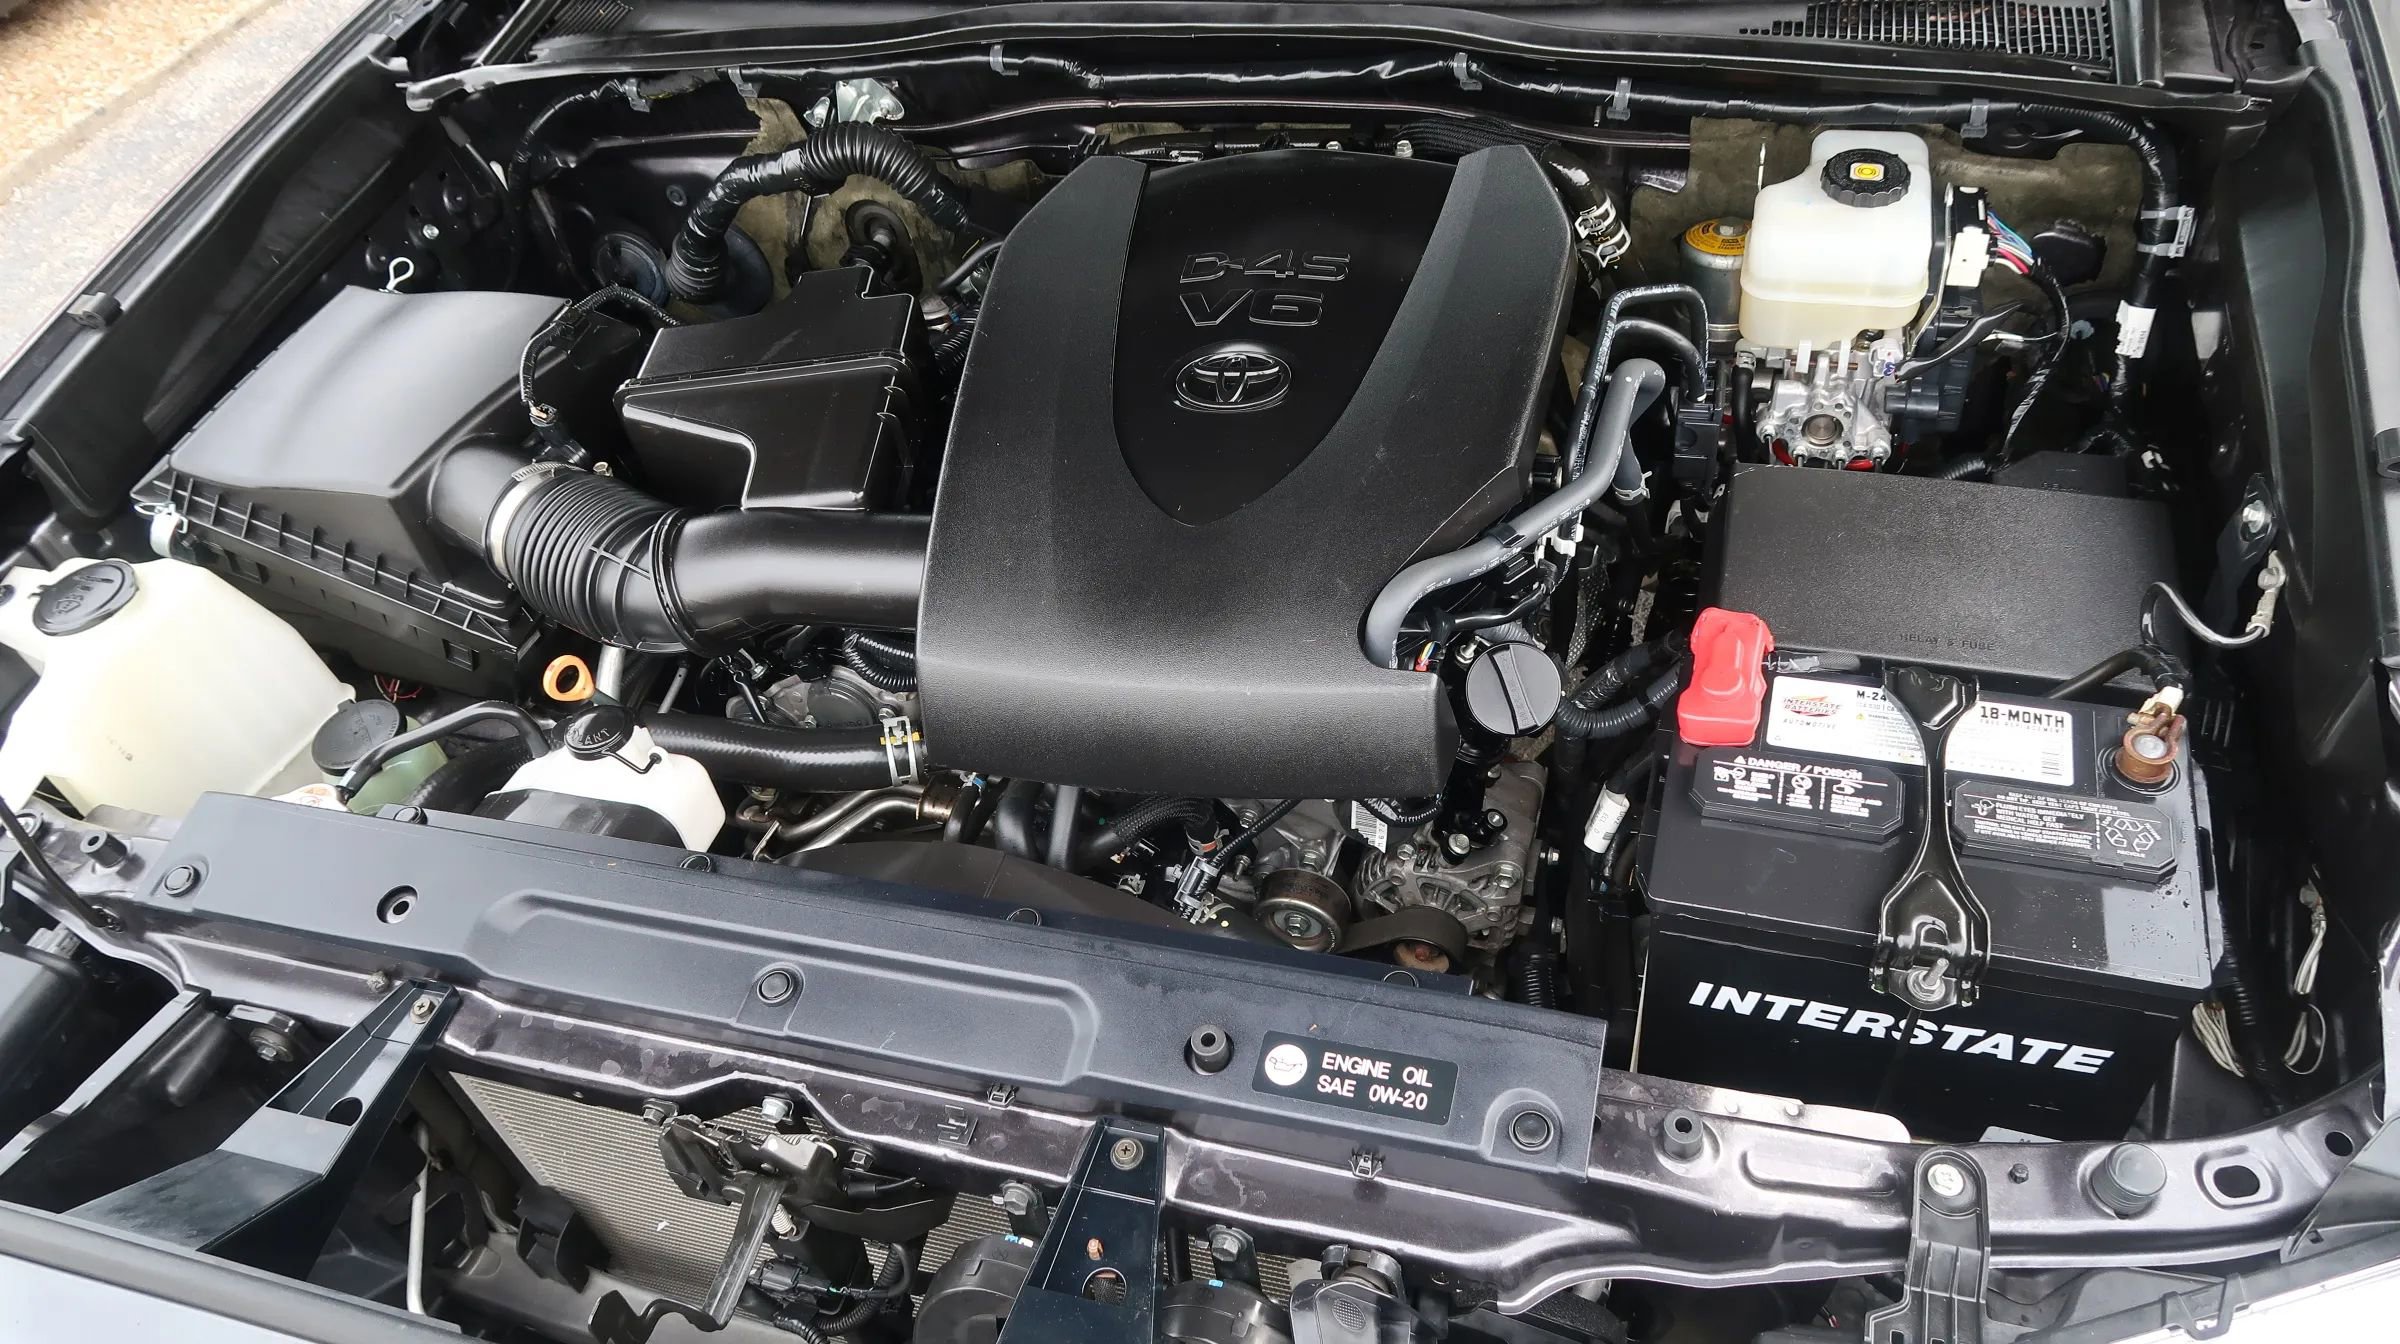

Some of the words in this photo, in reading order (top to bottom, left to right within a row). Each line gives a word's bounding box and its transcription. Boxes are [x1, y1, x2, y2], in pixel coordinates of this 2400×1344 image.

[1179, 249, 1351, 284] D-4S
[1179, 288, 1324, 327] V6
[1961, 639, 1997, 651] FUSE
[1783, 698, 1842, 711] INTERSTATE
[1783, 704, 1838, 715] BATTERIES
[1782, 718, 1837, 730] AUTOMOTIVE
[1980, 706, 2065, 728] 18-MONTH
[1747, 756, 1801, 772] DANGER
[1813, 765, 1863, 781] POISON
[1995, 802, 2018, 811] FLUSH
[2018, 806, 2037, 814] EYES
[2037, 809, 2084, 820] IMMEDIATELY
[1995, 809, 2015, 817] WITH
[2042, 815, 2057, 823] GET
[1995, 814, 2026, 825] MEDICAL
[2026, 818, 2045, 827] HELP
[2045, 821, 2064, 830] FAST
[1688, 981, 2115, 1074] INTERSTATE
[1321, 1051, 1392, 1080] ENGINE
[1402, 1066, 1433, 1088] OIL
[1316, 1074, 1357, 1098] SAE
[1368, 1084, 1428, 1111] 0W-20
